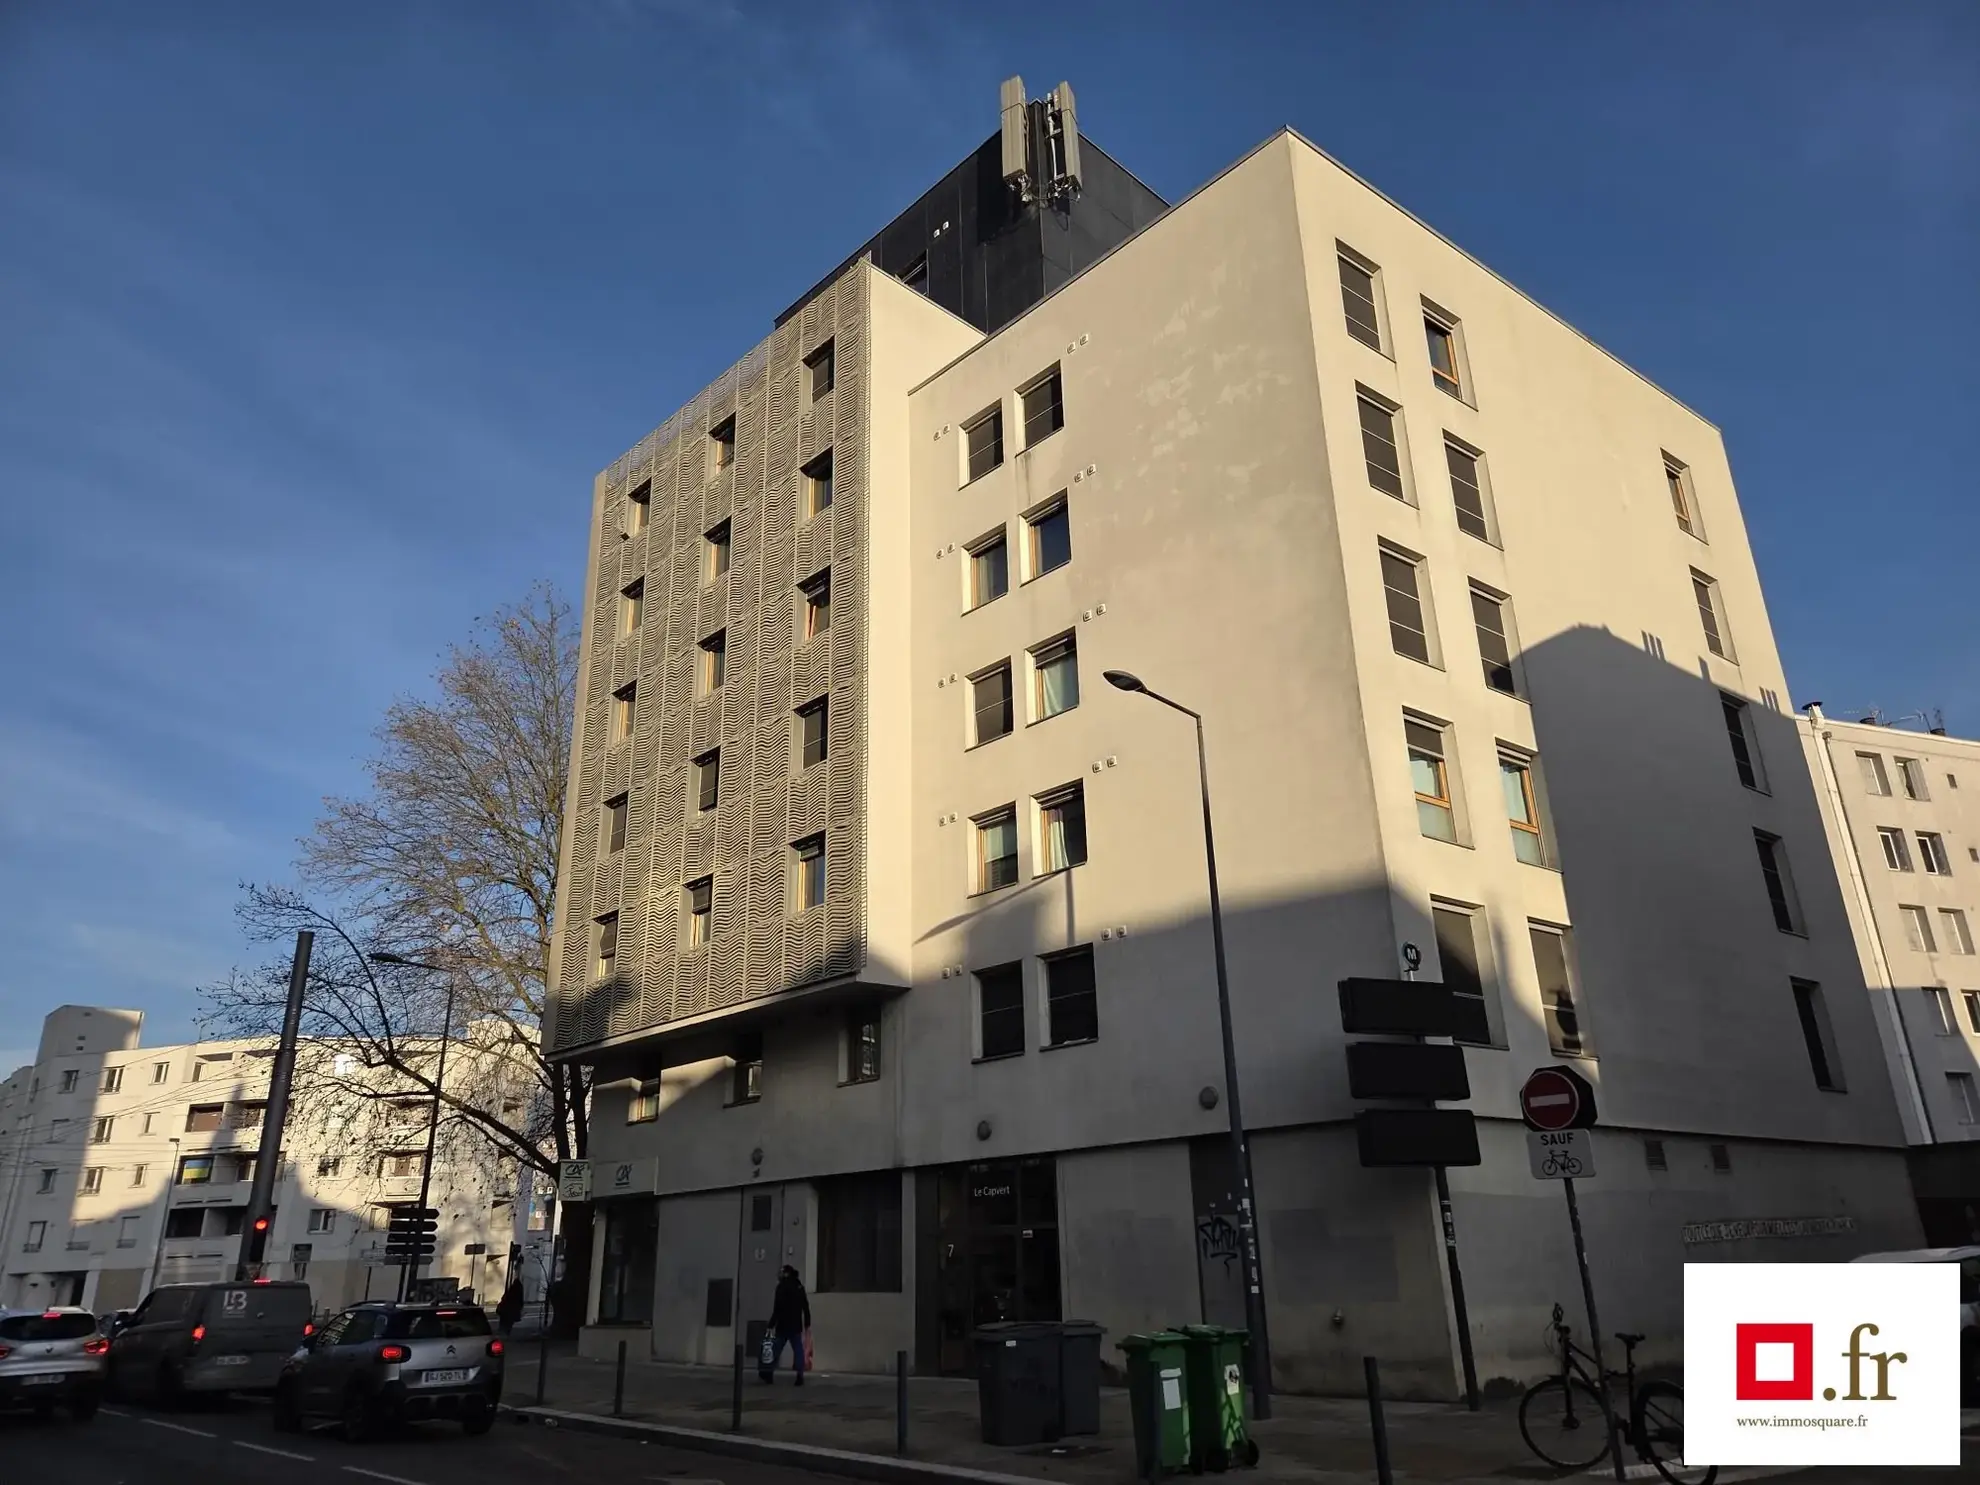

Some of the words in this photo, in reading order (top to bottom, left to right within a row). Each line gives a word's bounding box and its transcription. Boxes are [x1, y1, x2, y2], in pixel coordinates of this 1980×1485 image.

[1540, 1132, 1574, 1146] SAUF
[974, 1188, 982, 1196] Le
[948, 1244, 954, 1257] 7
